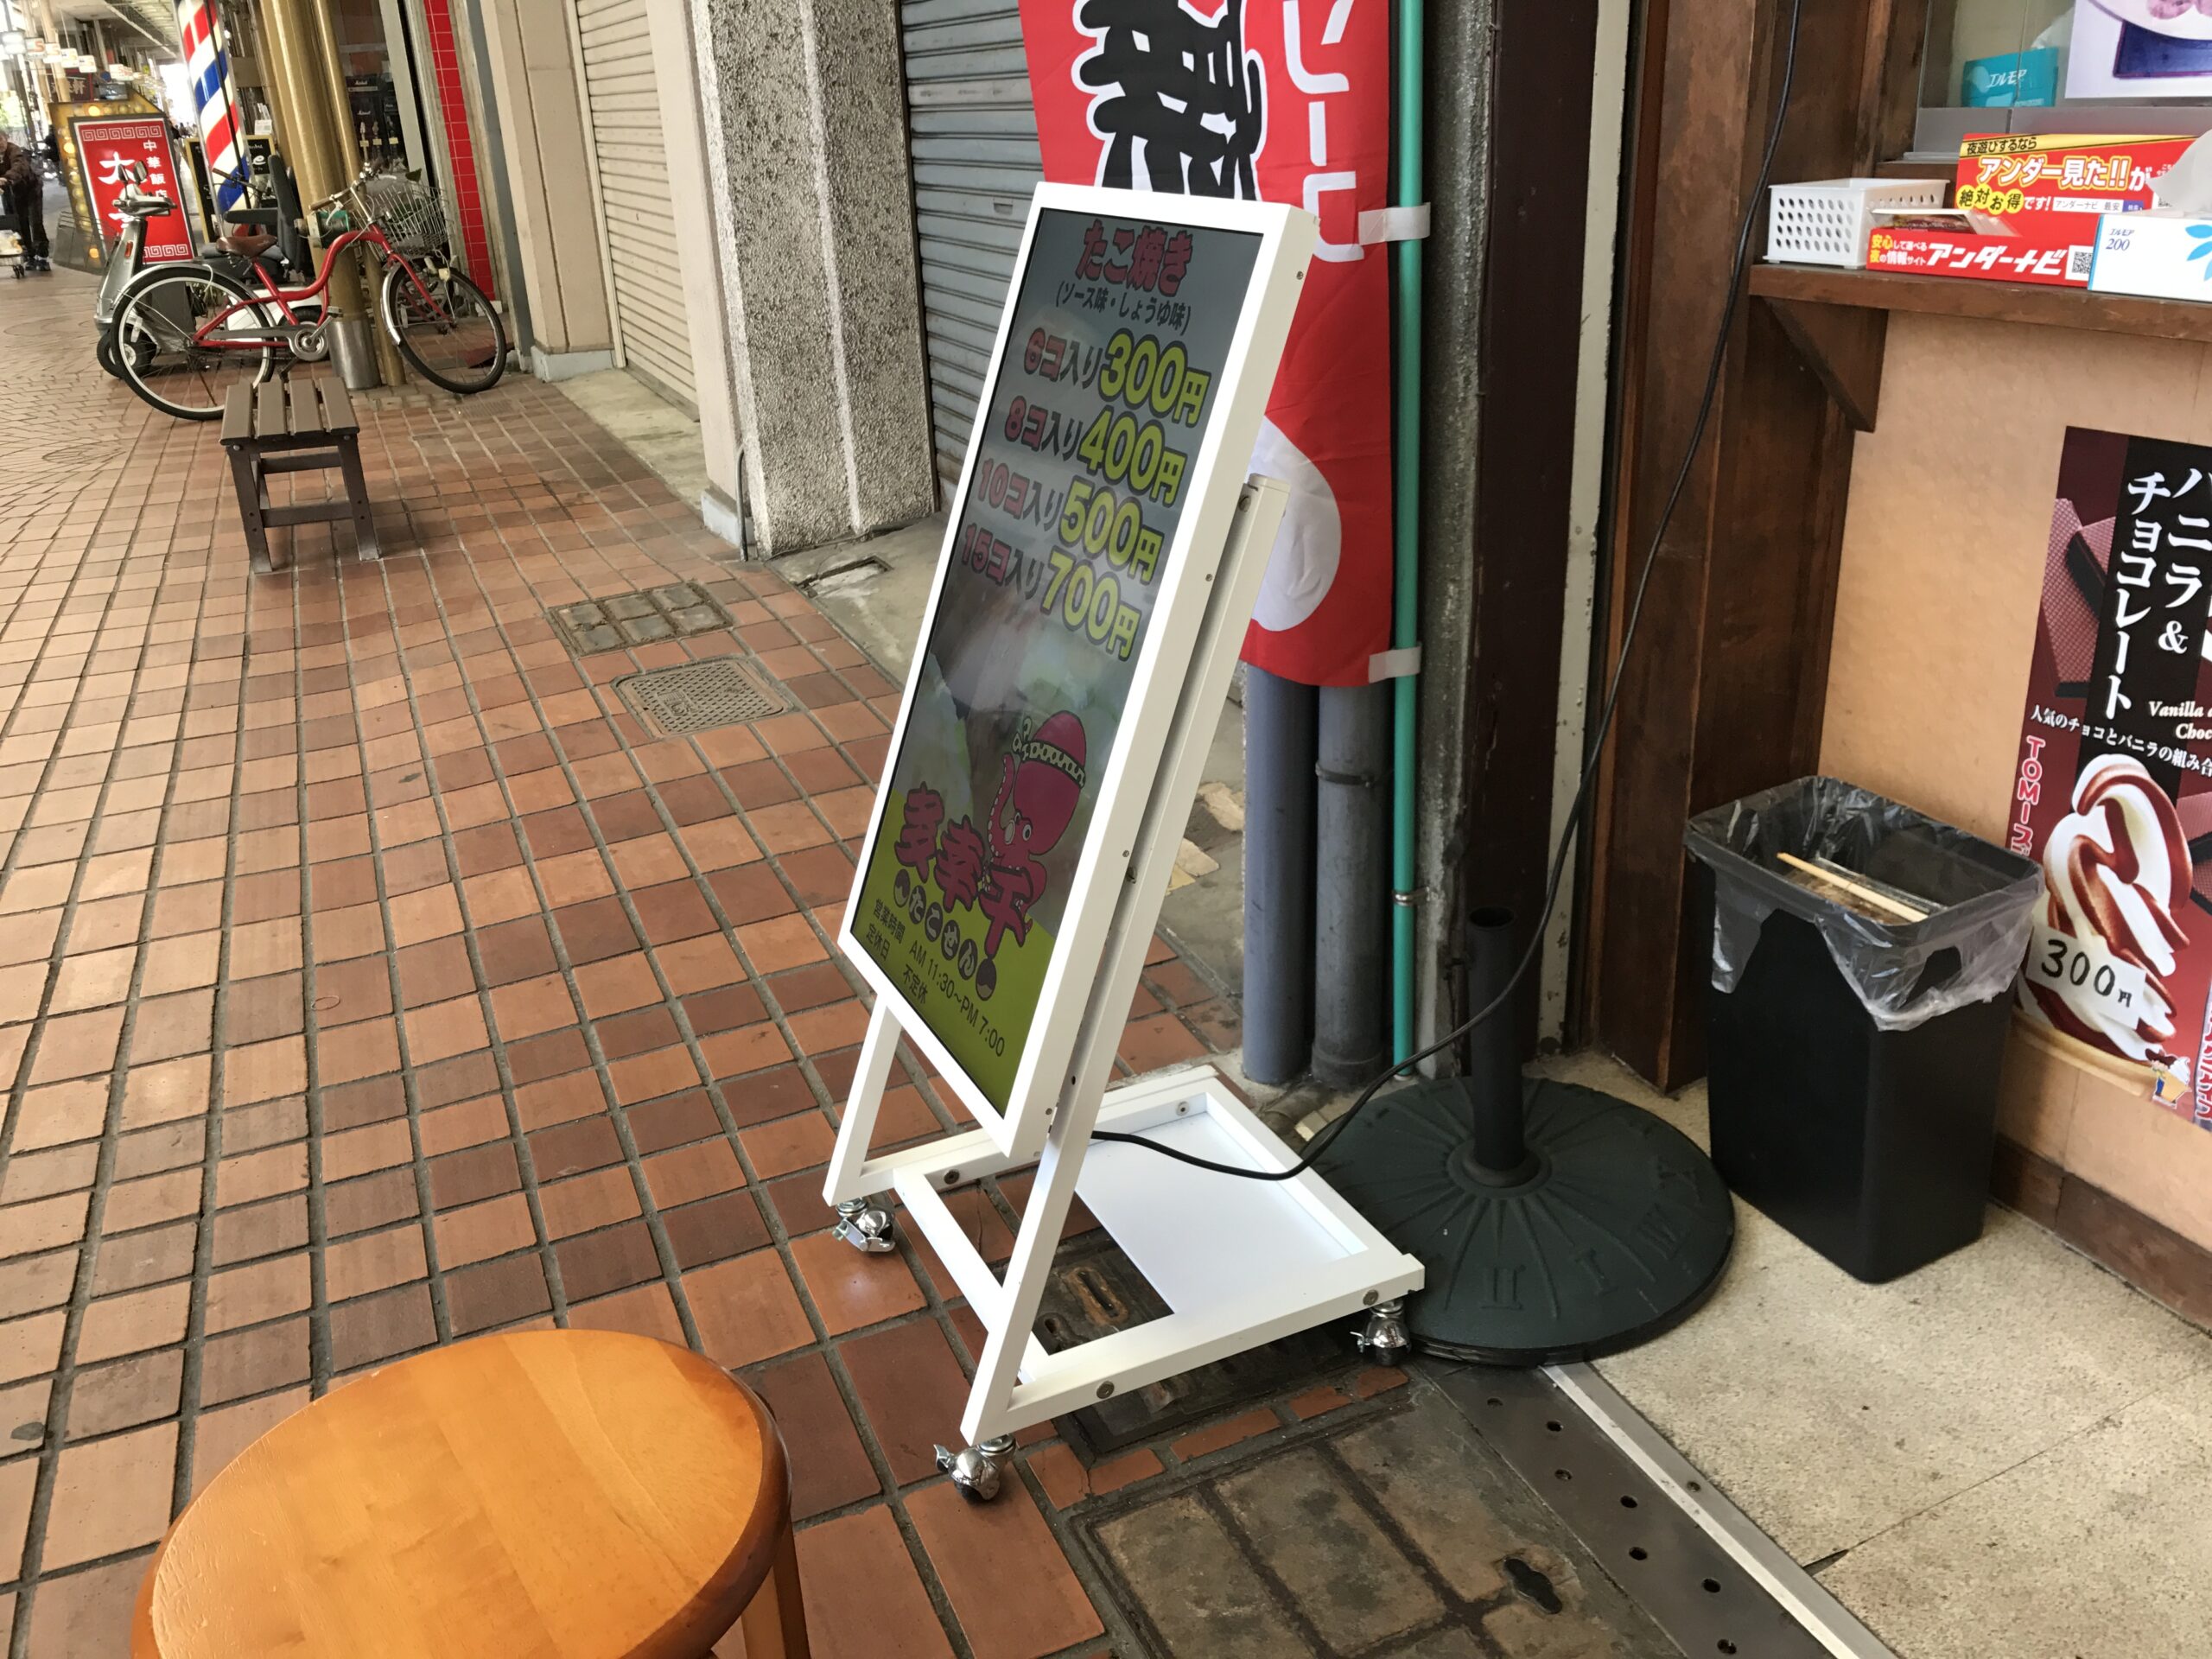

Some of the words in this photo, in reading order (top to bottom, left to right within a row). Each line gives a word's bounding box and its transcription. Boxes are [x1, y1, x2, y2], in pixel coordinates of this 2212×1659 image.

[1967, 137, 2037, 156] 夜遊びするなら
[2056, 200, 2099, 210] アンダーナビ
[1075, 219, 1193, 297] たこ焼き
[1927, 243, 2069, 276] アンダーナビ
[2106, 238, 2131, 251] 200
[2105, 472, 2171, 720] チョコレート
[2148, 701, 2204, 717] Vanilla
[866, 923, 891, 962] 定休日
[903, 963, 929, 1005] 不定休
[874, 899, 906, 944] 営業時間
[909, 940, 927, 969] AM
[978, 1016, 1005, 1057] 7:00
